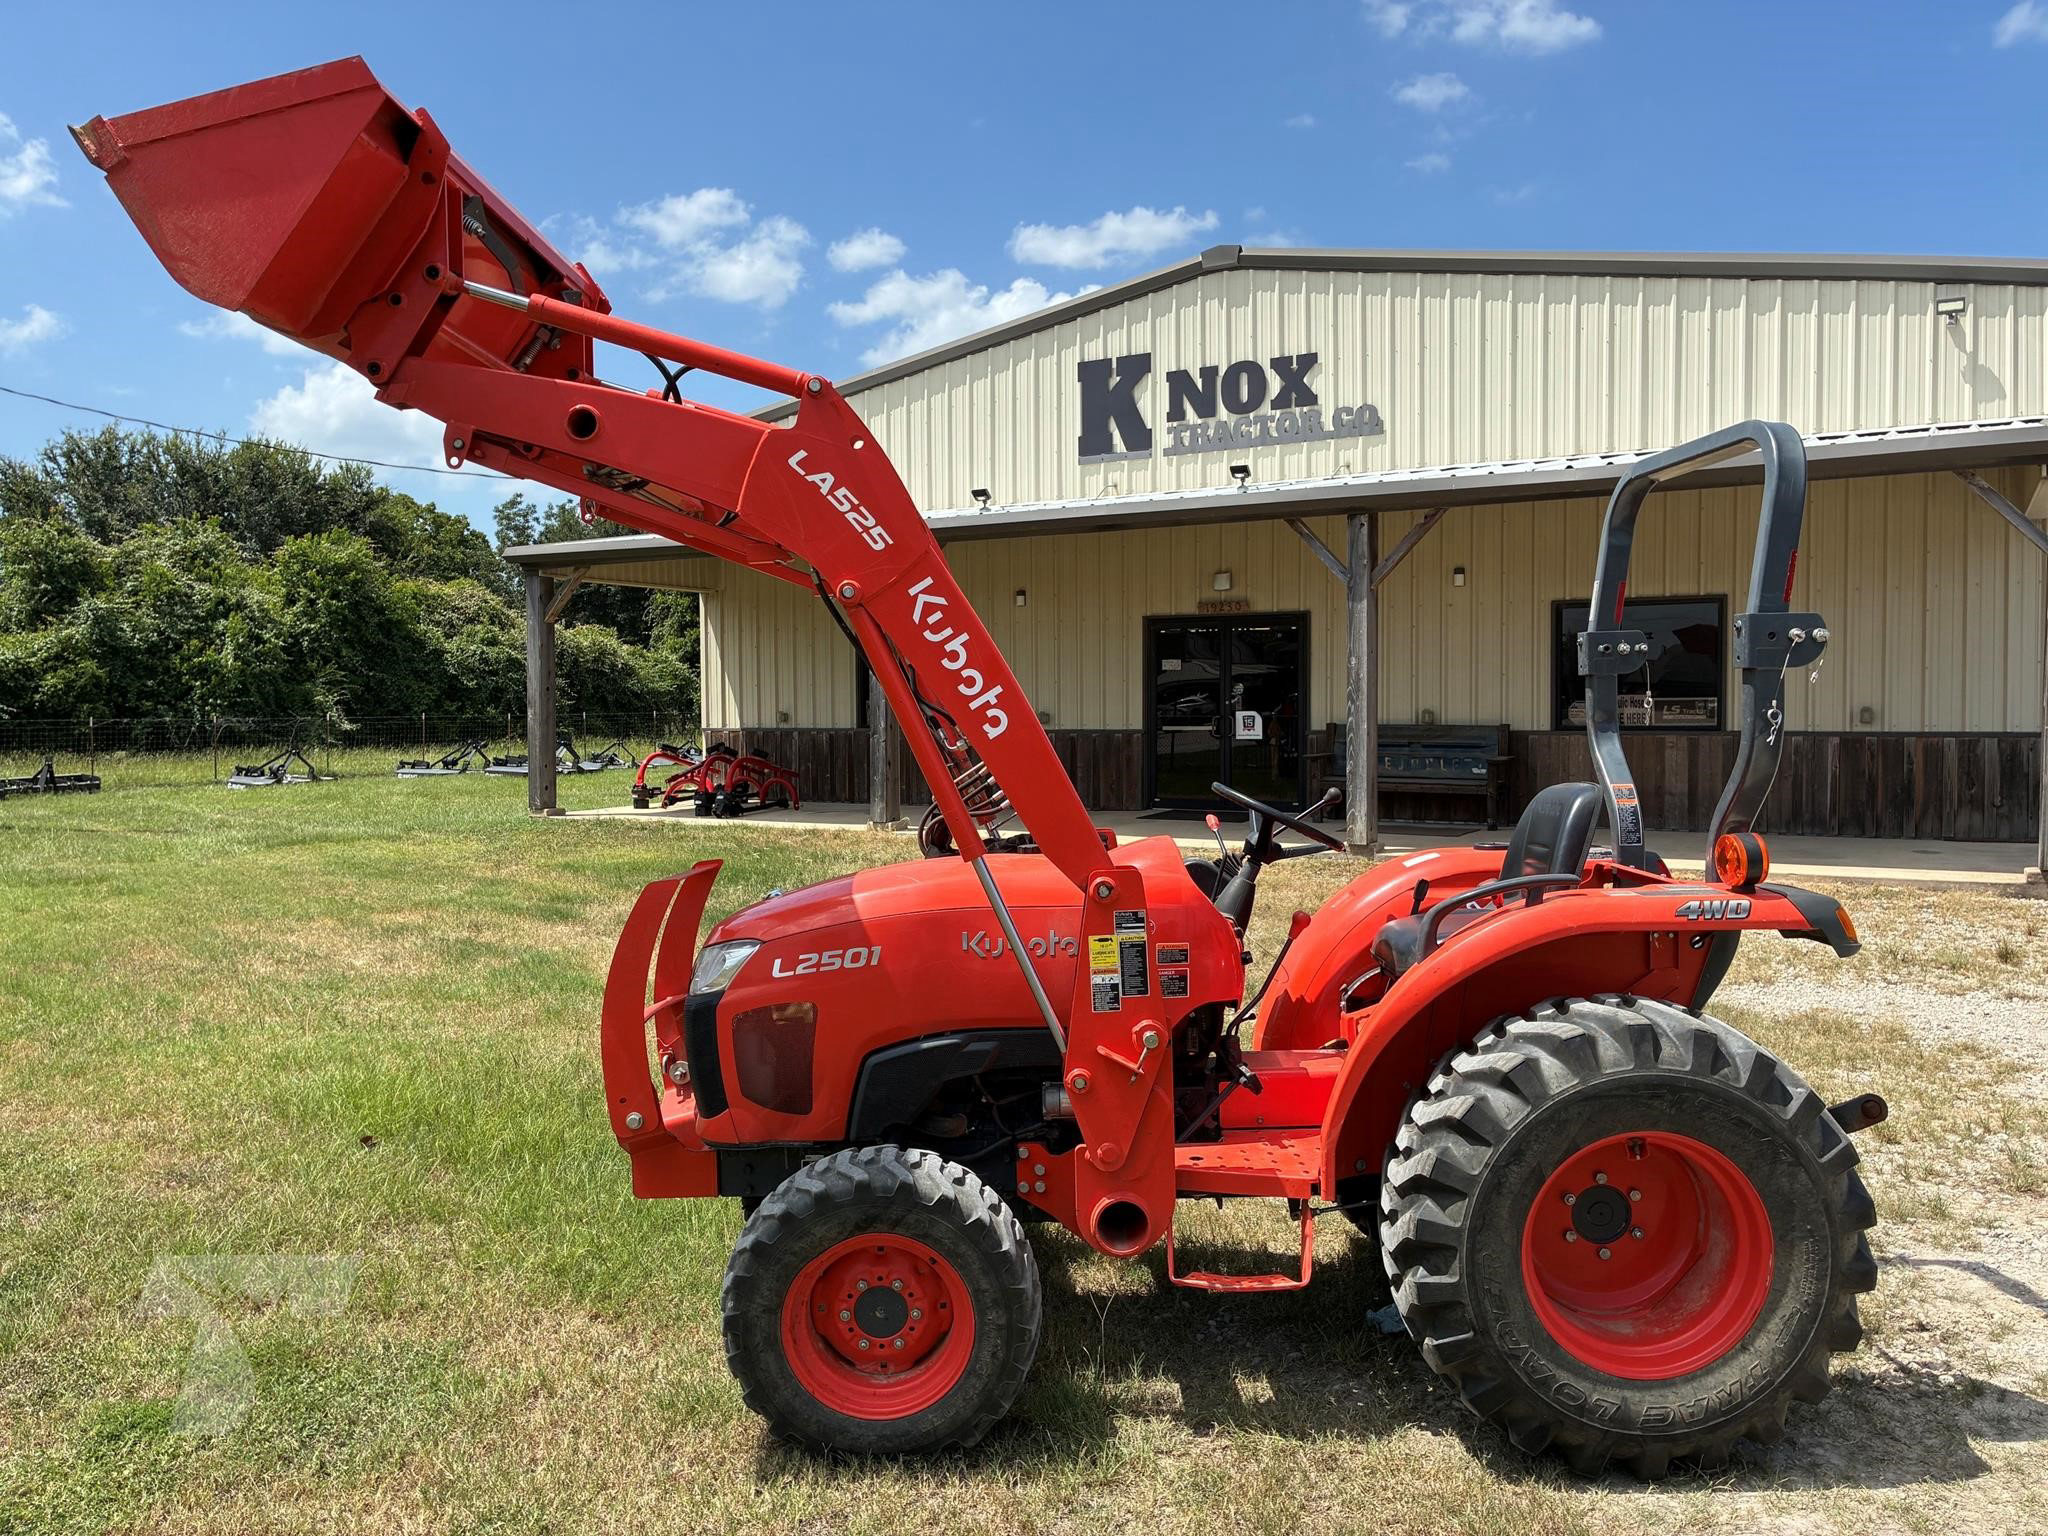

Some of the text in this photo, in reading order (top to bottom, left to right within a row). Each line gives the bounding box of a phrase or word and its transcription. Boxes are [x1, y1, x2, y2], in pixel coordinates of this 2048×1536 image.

[1078, 352, 1318, 457] KNOX
[1167, 410, 1322, 451] TRACTOR
[787, 449, 894, 551] LA525
[907, 576, 1009, 740] Kubota
[1663, 705, 1680, 714] LS
[1675, 899, 1751, 920] 4WD
[771, 946, 881, 979] L2501
[961, 930, 1079, 958] Kuota
